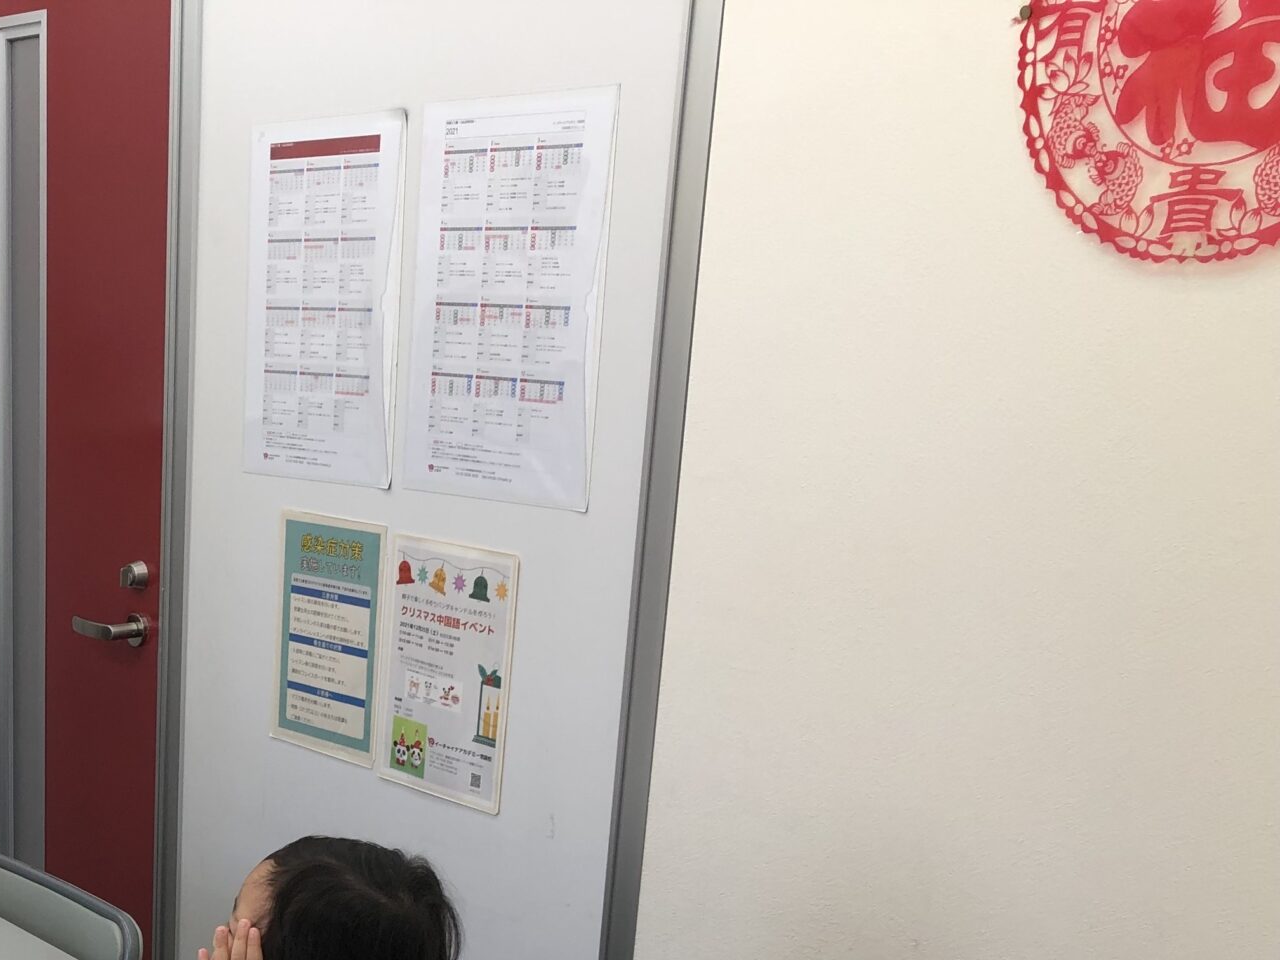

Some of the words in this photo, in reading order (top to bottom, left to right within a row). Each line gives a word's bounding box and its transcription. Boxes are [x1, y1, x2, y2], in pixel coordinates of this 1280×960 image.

[300, 532, 364, 563] 感染症対策
[400, 605, 495, 636] クリスマス中国語イベント
